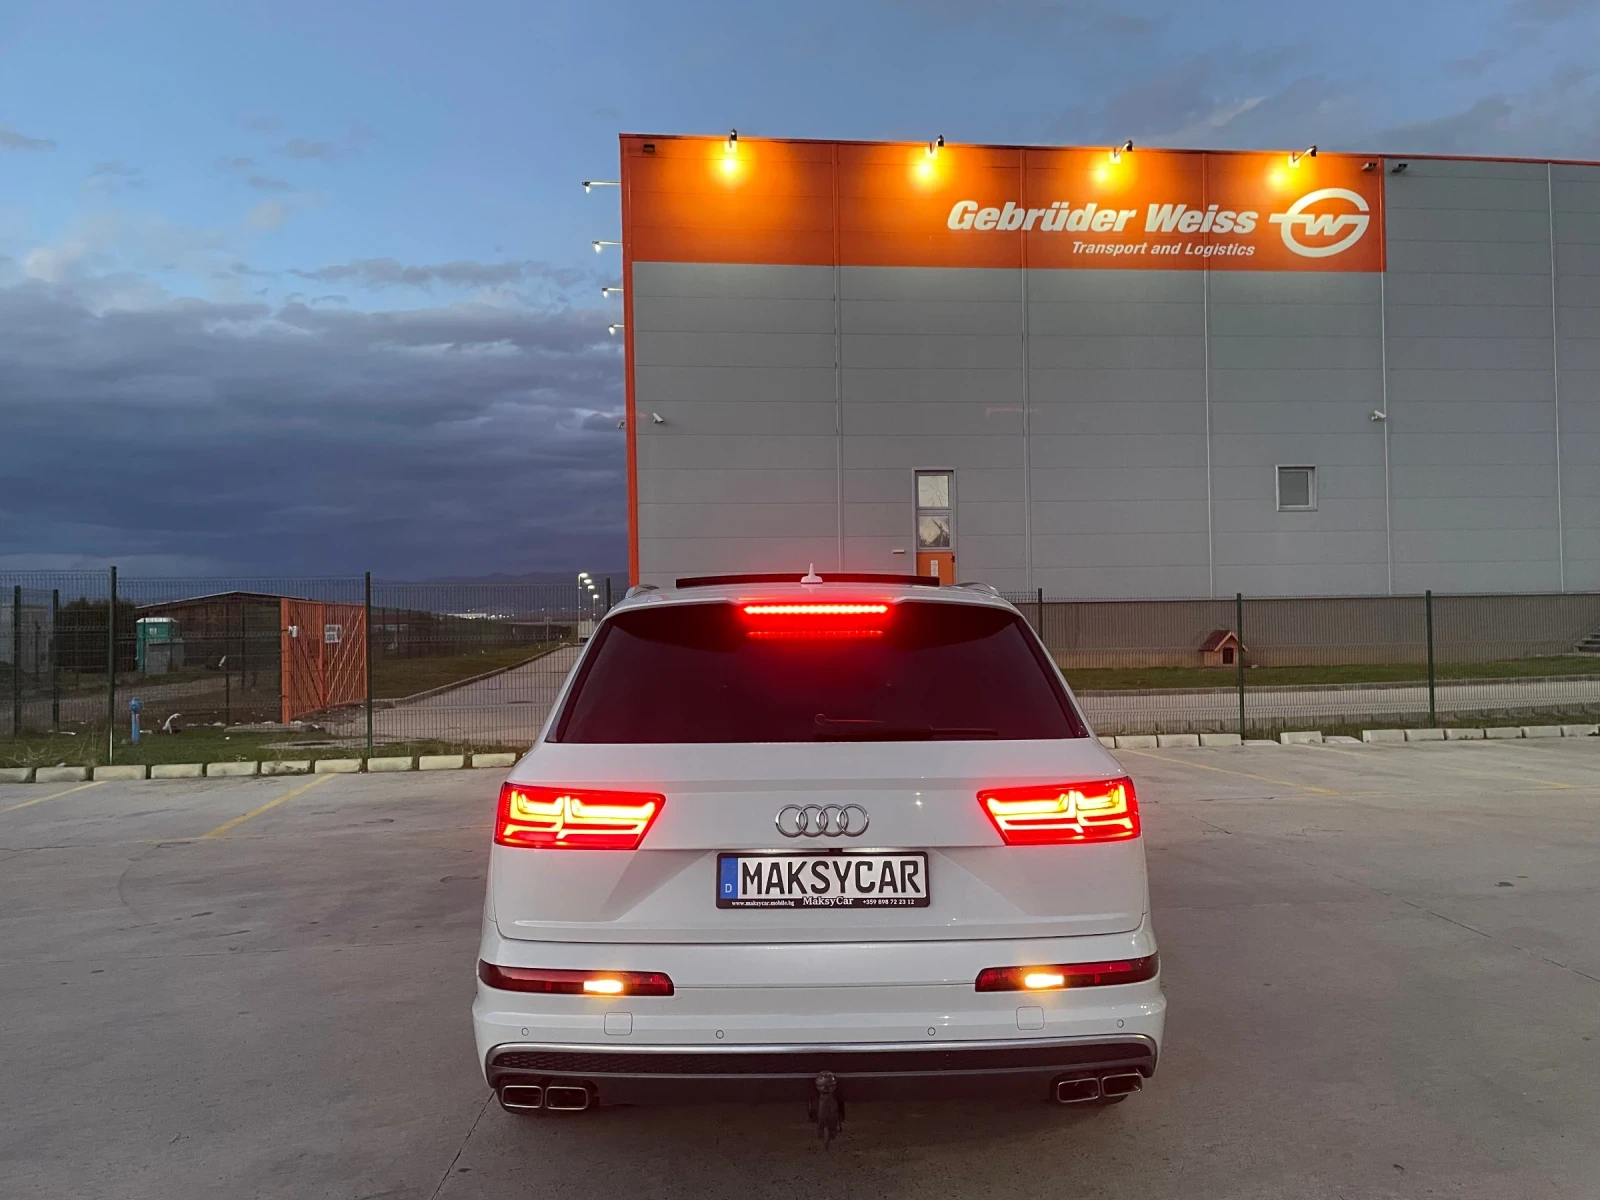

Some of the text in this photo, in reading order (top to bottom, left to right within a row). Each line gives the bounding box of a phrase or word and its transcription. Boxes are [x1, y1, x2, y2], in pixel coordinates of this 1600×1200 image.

[947, 200, 1258, 234] Gebrüder Weiss
[1072, 241, 1255, 258] Transport and Logistics
[742, 860, 921, 895] MAKSYCAR
[725, 883, 732, 893] D
[802, 896, 854, 906] MaksyCar
